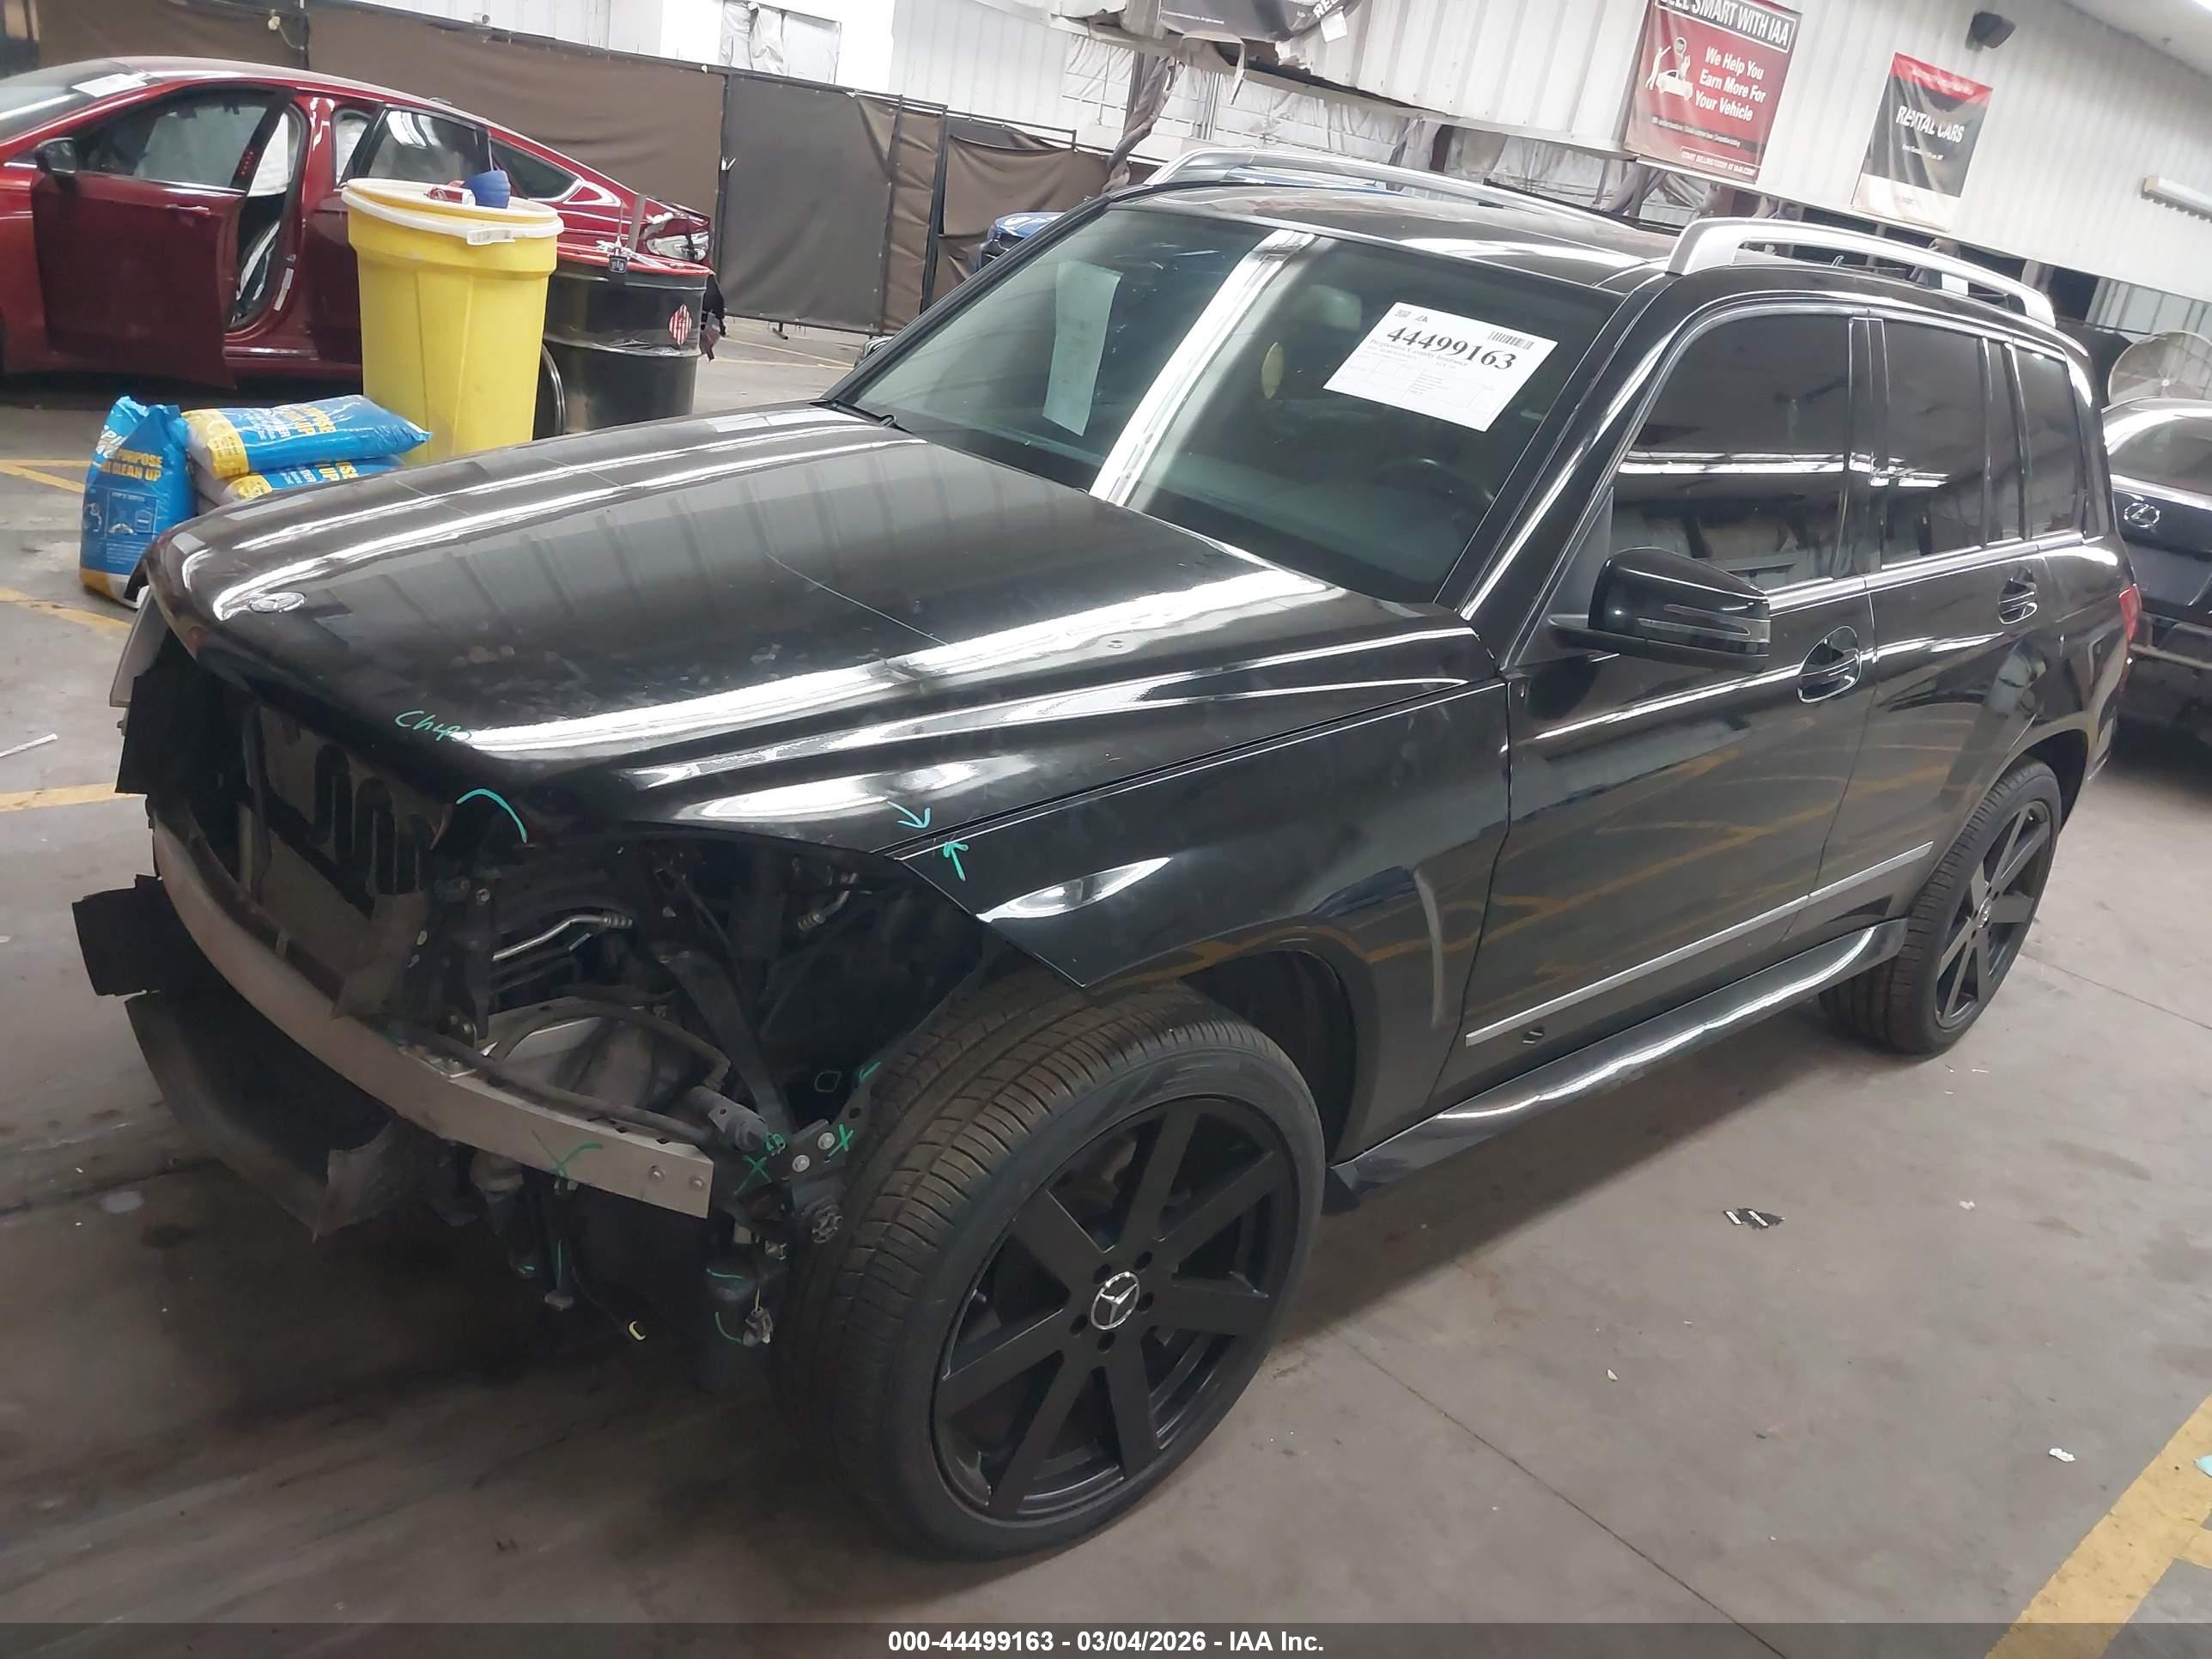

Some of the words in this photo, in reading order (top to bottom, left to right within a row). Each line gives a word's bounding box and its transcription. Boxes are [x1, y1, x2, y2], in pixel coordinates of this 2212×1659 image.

[1692, 0, 1738, 27] SMART
[1736, 6, 1767, 39] WITH
[1767, 18, 1790, 46] IAA
[1705, 46, 1721, 66] We
[1722, 52, 1745, 76] Help
[1746, 59, 1765, 81] You
[1699, 68, 1723, 90] Earn
[1723, 76, 1749, 98] More
[1750, 83, 1767, 104] For
[1694, 89, 1718, 111] Your
[1719, 96, 1753, 122] Vehicle
[1895, 105, 1936, 136] RENTAL
[1936, 123, 1966, 143] CARS
[1386, 326, 1517, 370] 44499163
[144, 468, 162, 482] UP
